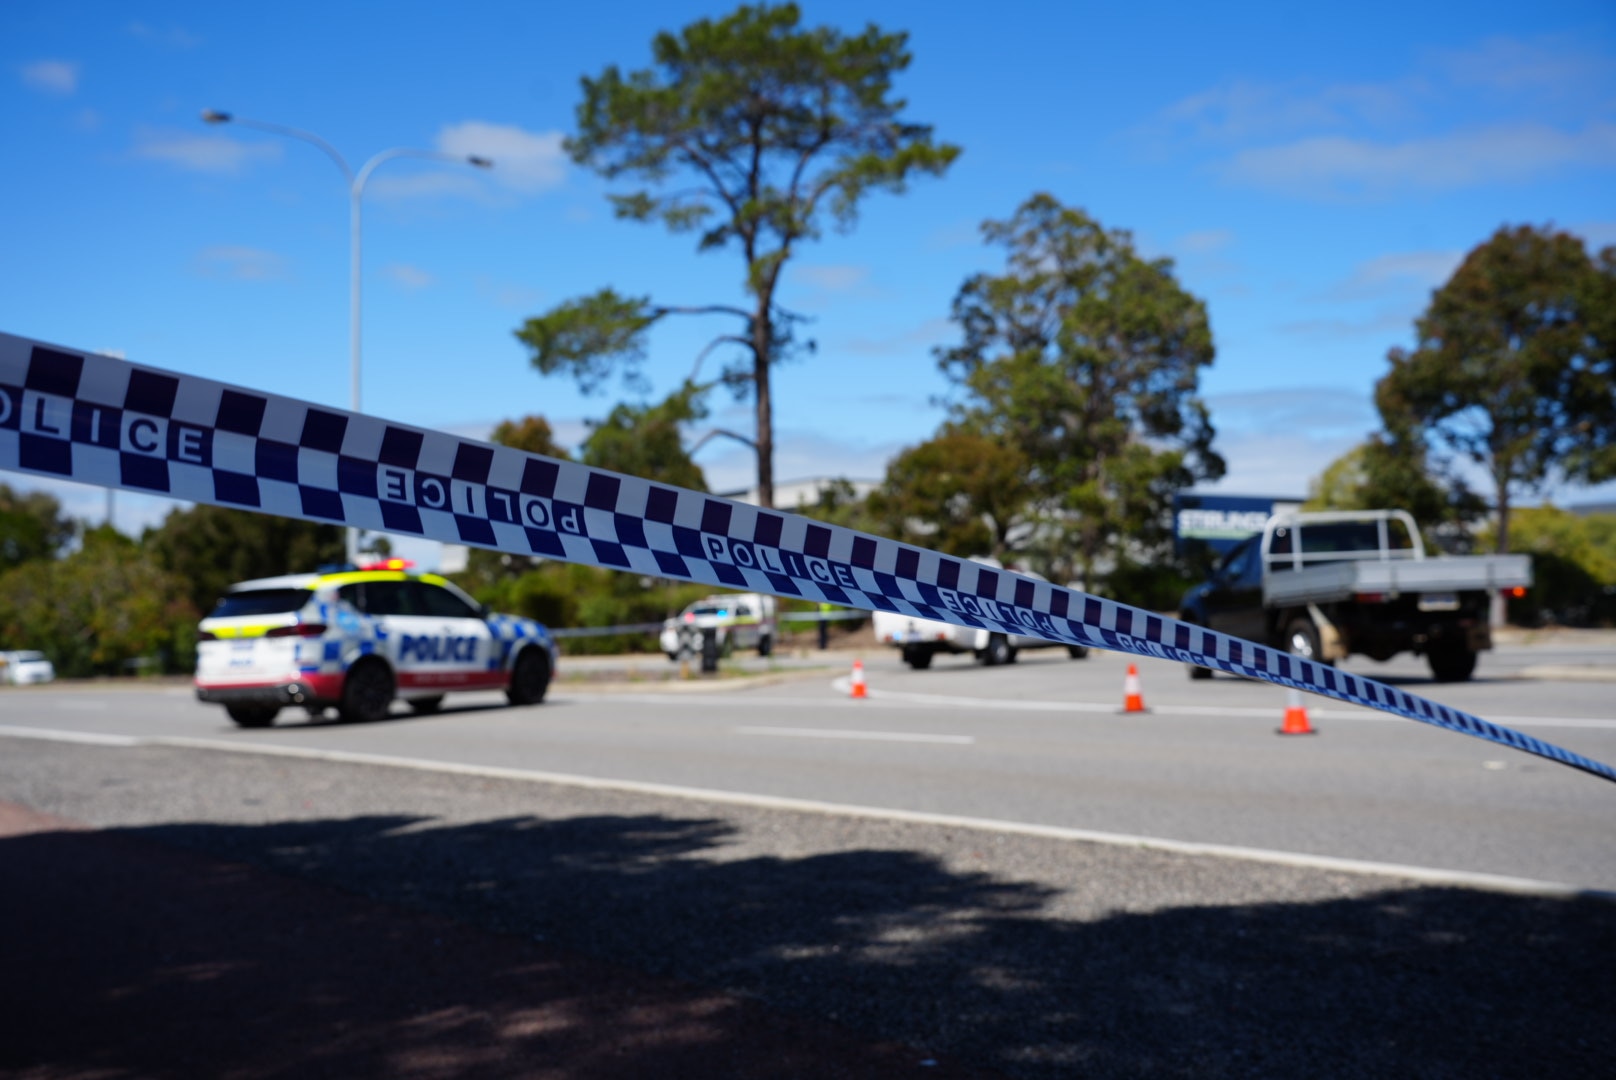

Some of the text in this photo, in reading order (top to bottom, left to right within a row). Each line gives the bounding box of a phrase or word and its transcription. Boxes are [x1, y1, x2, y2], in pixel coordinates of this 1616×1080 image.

[384, 468, 581, 534] POLICE
[706, 536, 855, 588] POLICE
[940, 590, 1057, 633] POLICE
[399, 634, 478, 662] POLICE
